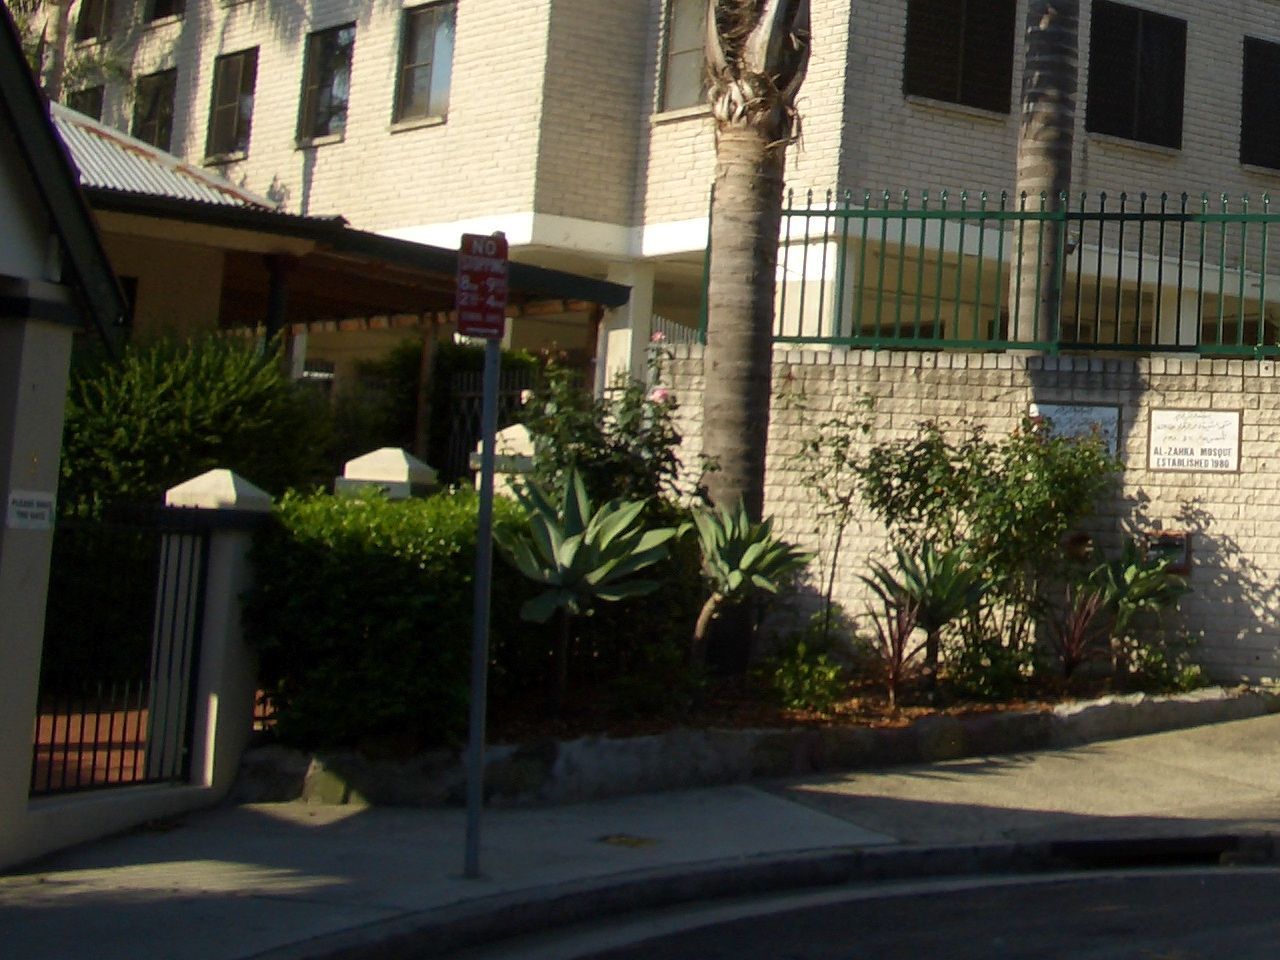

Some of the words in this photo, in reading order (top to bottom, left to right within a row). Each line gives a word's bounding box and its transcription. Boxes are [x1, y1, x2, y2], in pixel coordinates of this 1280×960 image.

[472, 240, 497, 256] NO
[1153, 447, 1195, 456] AL-ZAHRA
[1200, 447, 1232, 458] MOSQUE
[1156, 458, 1209, 468] ESTABLISHED
[1211, 458, 1230, 468] 1980
